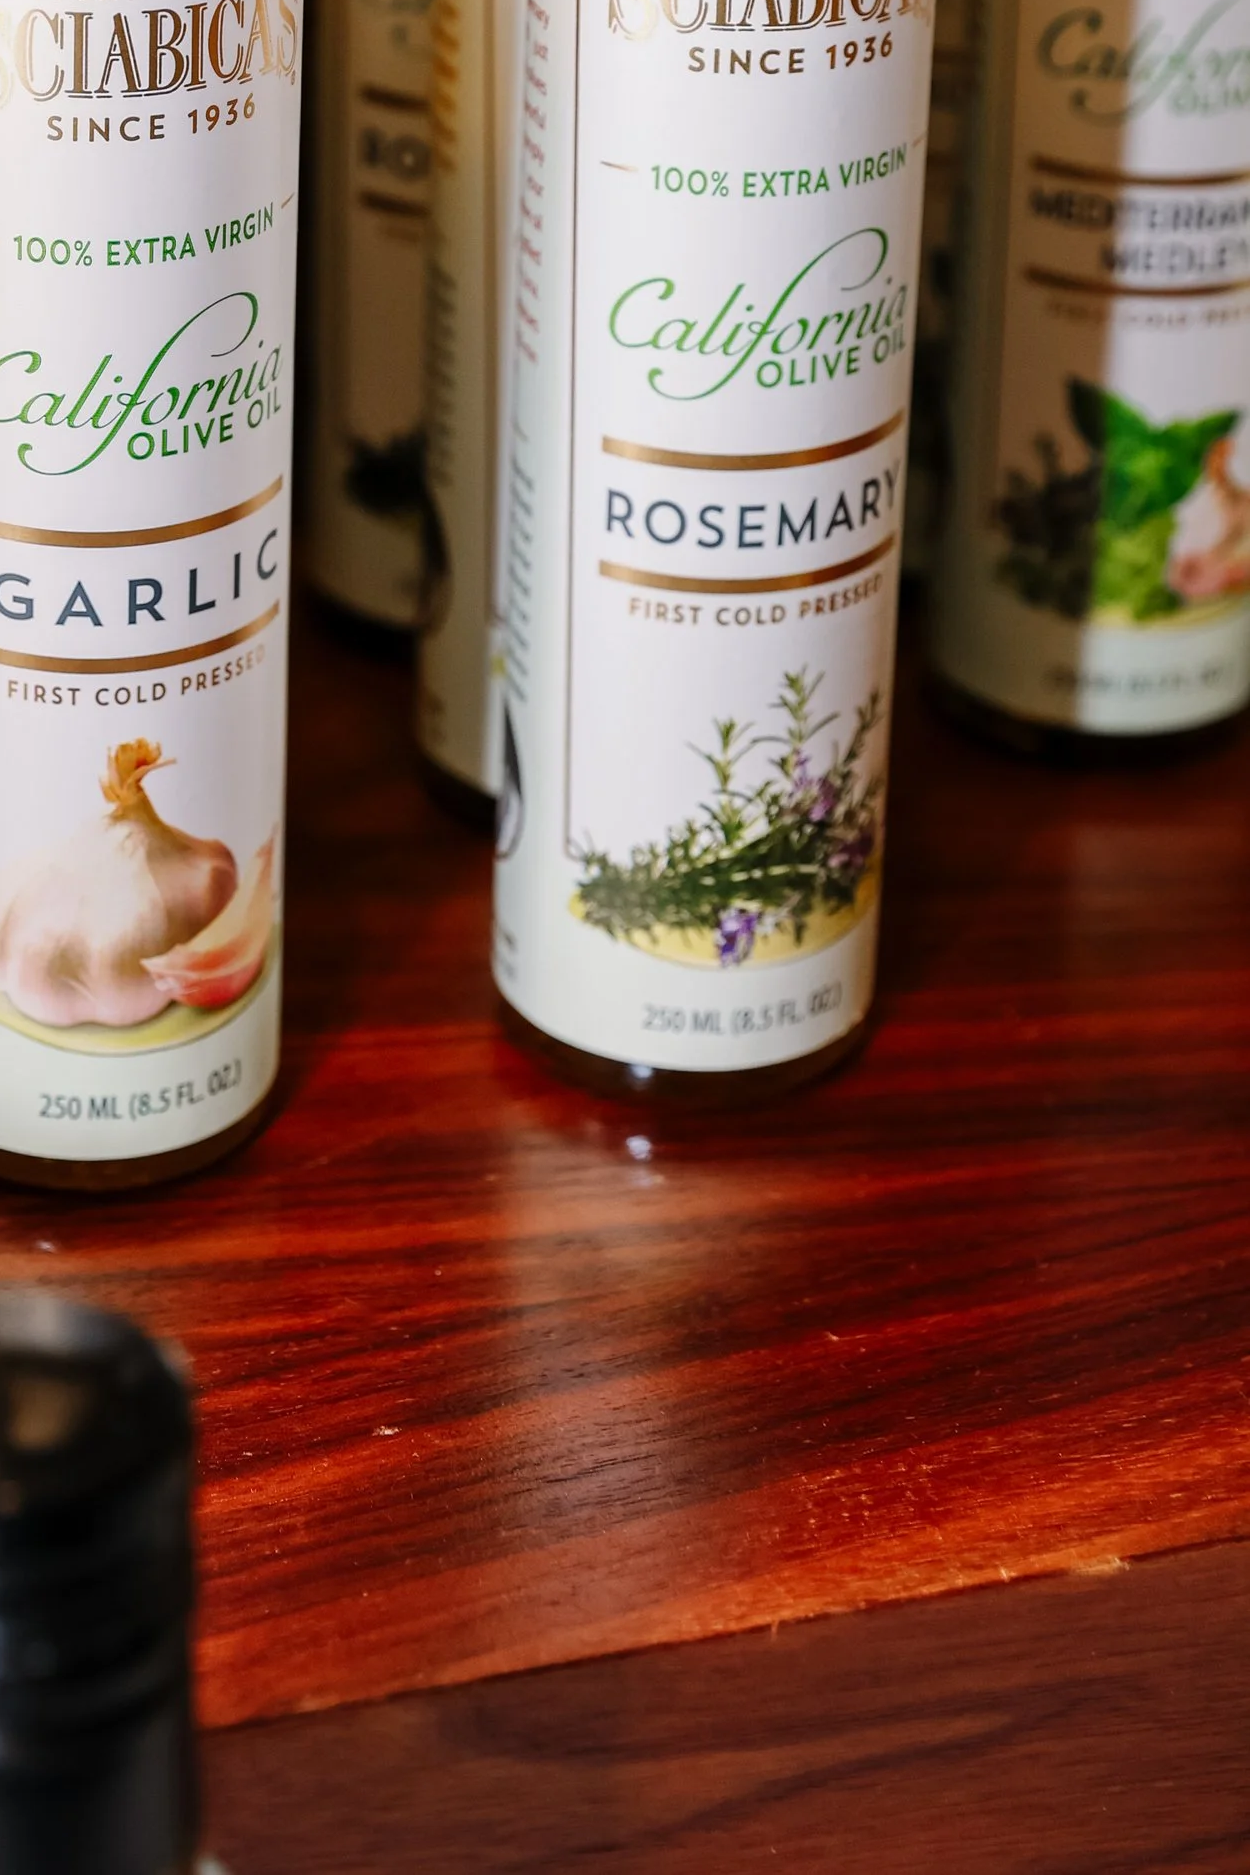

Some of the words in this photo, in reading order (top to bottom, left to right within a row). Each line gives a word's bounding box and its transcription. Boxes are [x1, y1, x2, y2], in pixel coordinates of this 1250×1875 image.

[687, 46, 806, 76] SINCE
[825, 31, 894, 70] 1936
[46, 114, 166, 143] SINCE
[187, 92, 257, 135] 1936
[650, 163, 730, 198] 100%
[742, 167, 831, 199] EXTRA
[838, 141, 908, 190] VIRGIN
[13, 234, 93, 267] 100%
[105, 232, 197, 267] EXTRA
[204, 201, 274, 254] VIRGIN
[608, 225, 910, 402] California
[756, 345, 862, 389] OLIVE
[872, 322, 908, 366] OIL
[126, 411, 235, 461] OLIVE
[246, 385, 282, 429] OIL
[605, 455, 903, 551] ROSEMARY
[628, 597, 704, 627] FIRST
[715, 604, 787, 627] COLD
[799, 571, 884, 620] PRESSED
[6, 679, 82, 707] FIRST
[95, 681, 169, 707] COLD
[180, 641, 267, 696] PRESSED
[641, 1002, 686, 1033] 250
[691, 1008, 724, 1036] ML
[37, 1092, 83, 1121] 250
[87, 1095, 123, 1121] ML
[127, 1087, 172, 1123] (8.5
